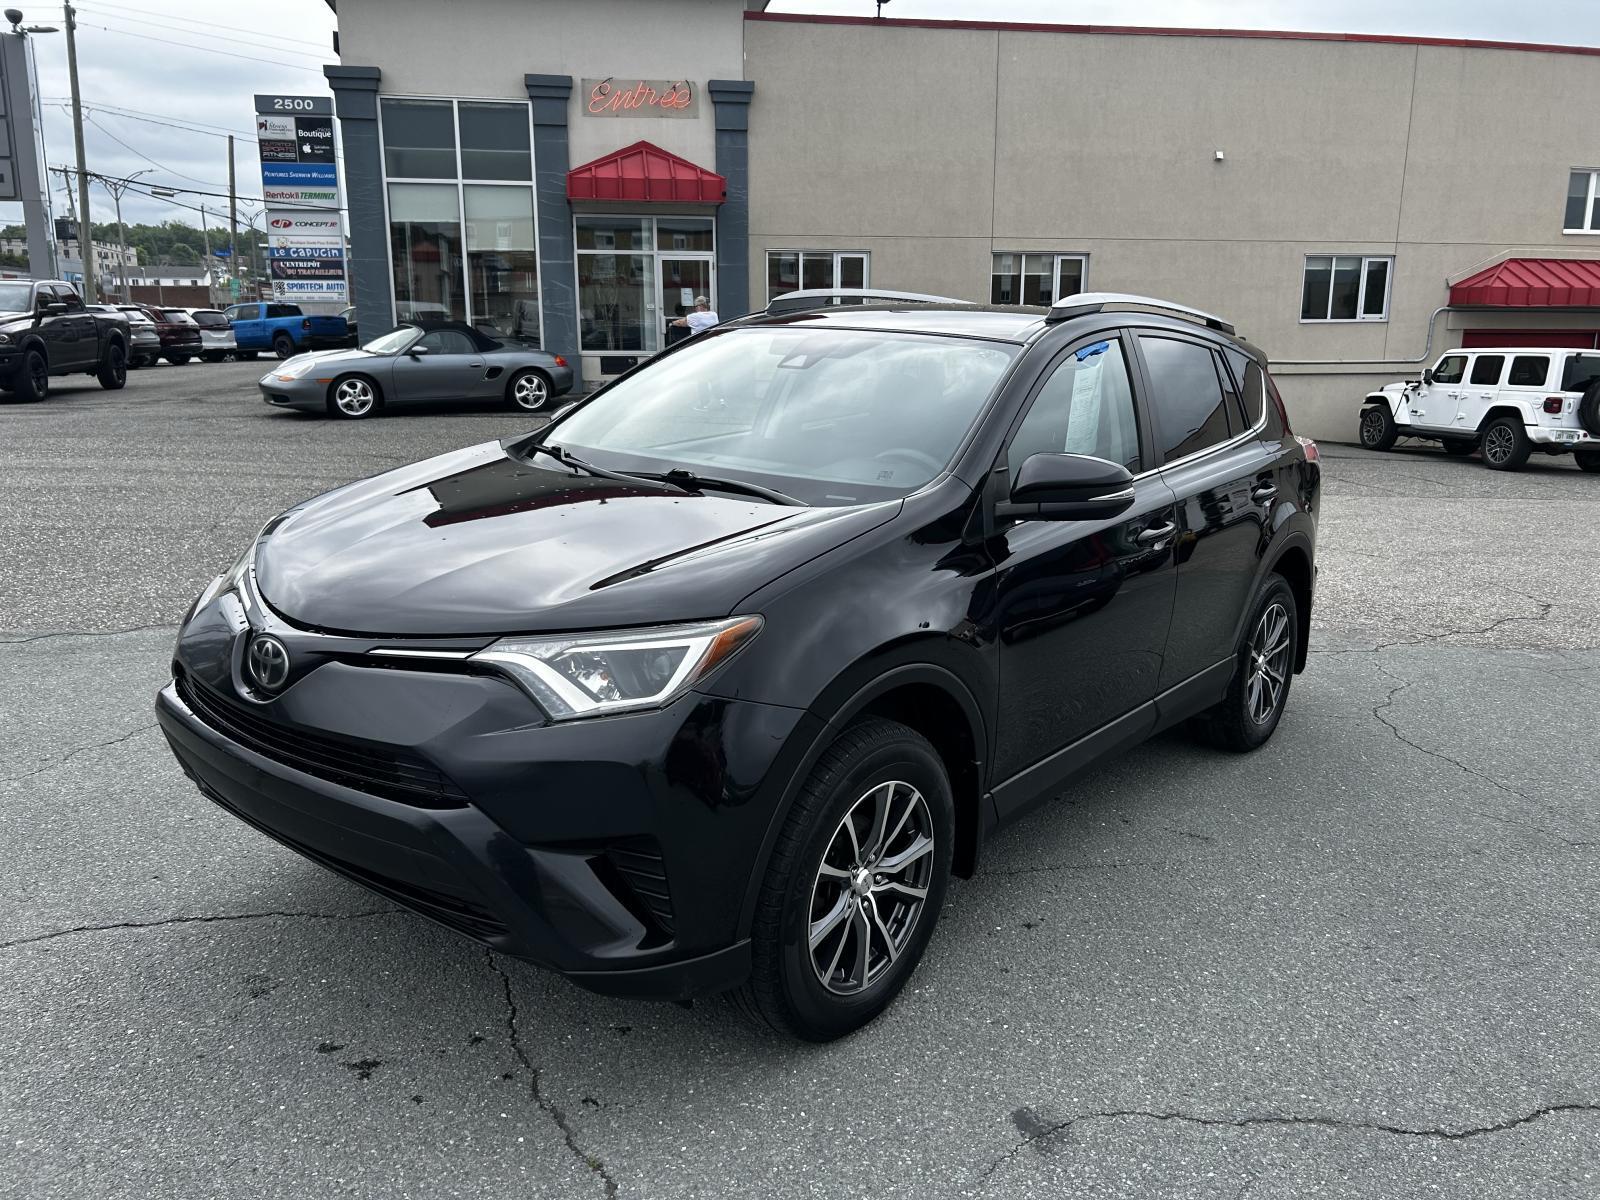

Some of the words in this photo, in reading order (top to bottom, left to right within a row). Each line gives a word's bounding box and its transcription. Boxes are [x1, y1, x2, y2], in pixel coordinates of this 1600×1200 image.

[588, 81, 691, 113] Entrée
[274, 98, 314, 110] 2500
[298, 129, 332, 139] Boutique
[265, 191, 299, 200] Rentokil
[300, 192, 337, 200] TERMINIX
[274, 249, 286, 257] Le
[286, 283, 324, 291] SPORTECH
[327, 283, 345, 291] AUTO
